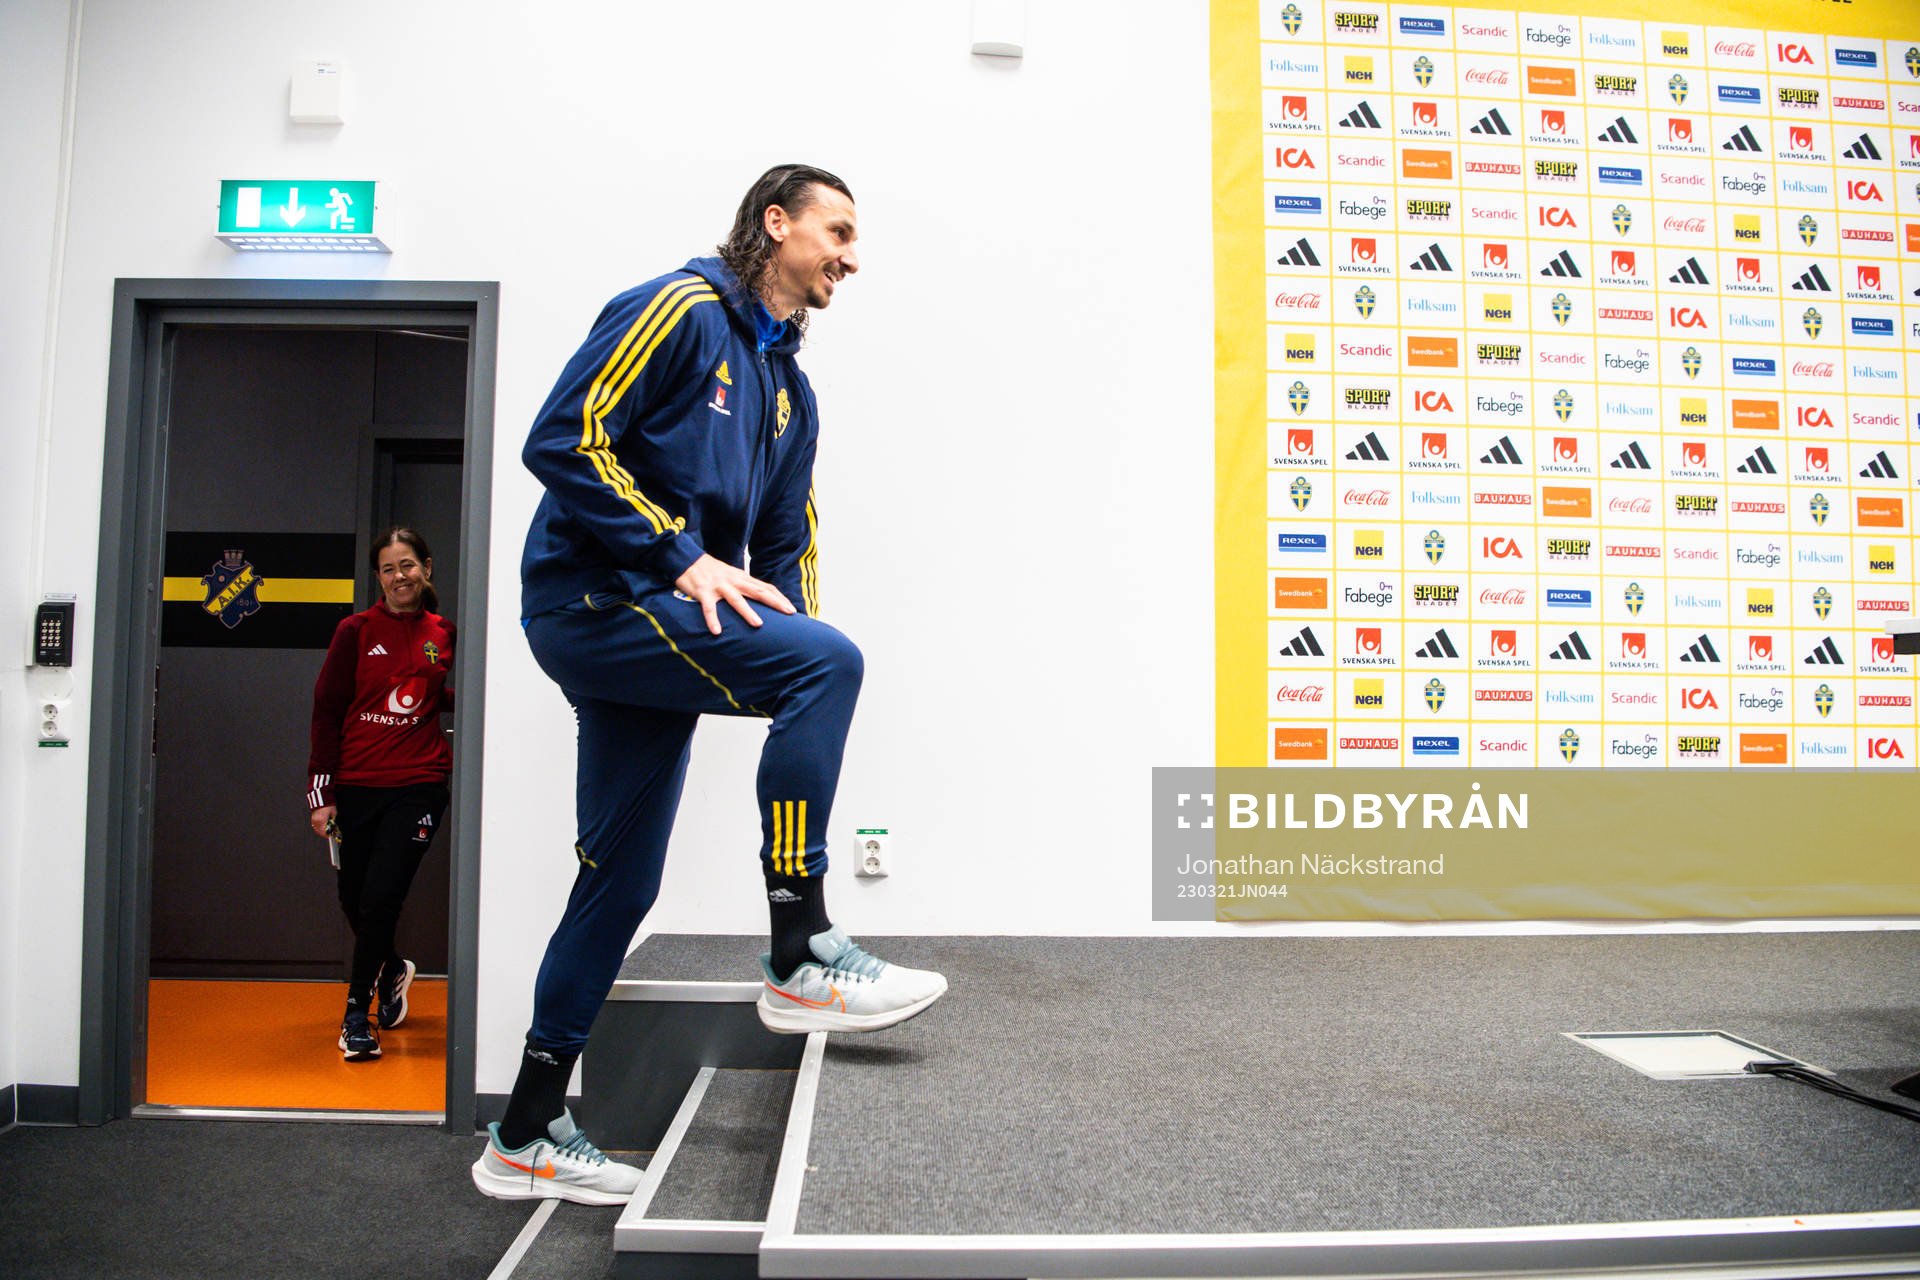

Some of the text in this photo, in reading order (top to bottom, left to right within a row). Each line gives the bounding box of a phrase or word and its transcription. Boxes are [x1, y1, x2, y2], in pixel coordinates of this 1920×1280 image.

[1335, 13, 1378, 30] SPORT
[1462, 25, 1506, 37] Scandic
[1526, 28, 1570, 47] Fabege
[1590, 33, 1635, 46] Folksam
[1778, 43, 1814, 64] ICA
[1270, 60, 1318, 72] Folksam
[1595, 76, 1636, 92] SPORT
[1779, 88, 1819, 105] SPORT
[1834, 96, 1885, 110] BAUHAUS
[1276, 148, 1315, 169] ICA
[1338, 154, 1384, 166] Scandic
[1465, 162, 1520, 175] BAUHAUS
[1535, 161, 1578, 178] SPORT
[1661, 174, 1704, 185] Scandic
[1723, 176, 1766, 195] Fabege
[1784, 180, 1827, 193] Folksam
[1848, 180, 1884, 202] ICA
[1340, 200, 1386, 220] Fabege
[1407, 200, 1451, 216] SPORT
[1472, 208, 1516, 219] Scandic
[1539, 206, 1577, 228] ICA
[1842, 229, 1894, 242] BAUHAUS
[1408, 298, 1456, 312] Folksam
[1599, 308, 1653, 321] BAUHAUS
[1670, 307, 1708, 328] ICA
[1730, 314, 1774, 328] Folksam
[1340, 344, 1392, 356] Scandic
[1478, 344, 1521, 360] SPORT
[1540, 352, 1584, 364] Scandic
[1605, 354, 1649, 373] Fabege
[1853, 366, 1898, 379] Folksam
[1346, 389, 1390, 405] SPORT
[1414, 390, 1454, 412] ICA
[1478, 397, 1523, 416] Fabege
[1607, 403, 1652, 415] Folksam
[1798, 406, 1834, 428] ICA
[1853, 413, 1900, 426] Scandic
[1412, 491, 1460, 504] Folksam
[1474, 493, 1531, 505] BAUHAUS
[1676, 496, 1718, 512] SPORT
[1732, 502, 1785, 514] BAUHAUS
[1483, 537, 1523, 559] ICA
[1548, 540, 1590, 556] SPORT
[1606, 546, 1661, 558] BAUHAUS
[1674, 548, 1718, 559] Scandic
[1737, 549, 1780, 568] Fabege
[1798, 550, 1843, 562] Folksam
[1345, 588, 1392, 607] Fabege
[1414, 585, 1459, 601] SPORT
[1676, 596, 1720, 607] Folksam
[1857, 600, 1909, 612] BAUHAUS
[1475, 690, 1533, 702] BAUHAUS
[1546, 690, 1594, 703] Folksam
[1612, 692, 1657, 703] Scandic
[1682, 688, 1719, 710] ICA
[1740, 694, 1783, 712] Fabege
[1859, 696, 1911, 707] BAUHAUS
[1340, 738, 1398, 750] BAUHAUS
[1480, 740, 1527, 751] Scandic
[1612, 740, 1657, 759] Fabege
[1678, 737, 1720, 752] SPORT
[1802, 742, 1846, 754] Folksam
[1868, 738, 1904, 759] ICA
